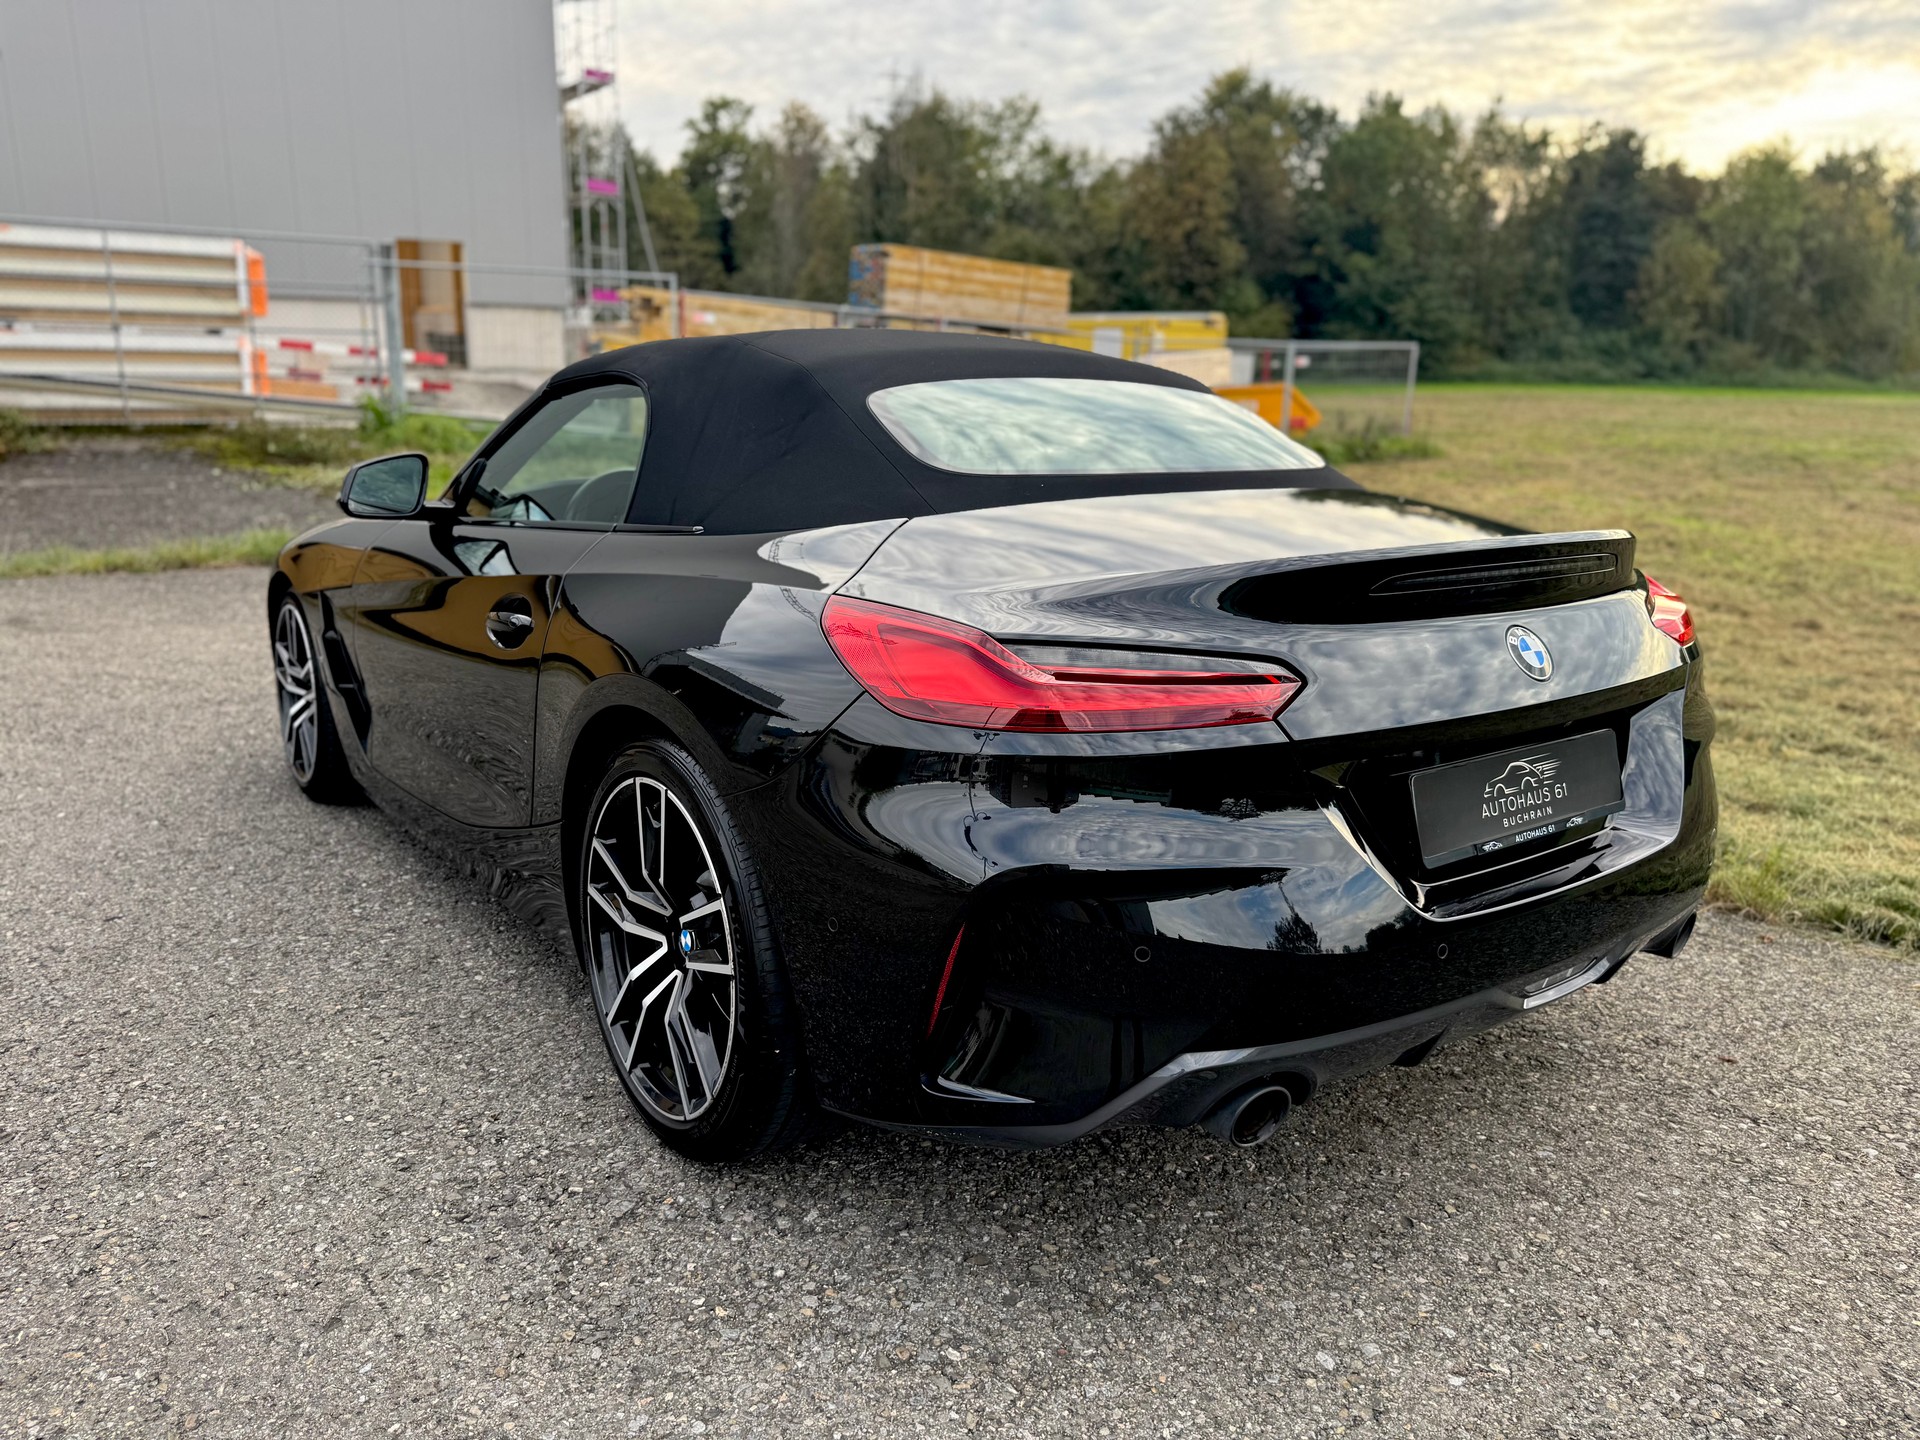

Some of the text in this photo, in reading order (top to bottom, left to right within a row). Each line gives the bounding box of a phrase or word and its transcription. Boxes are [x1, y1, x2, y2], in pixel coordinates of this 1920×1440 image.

[1482, 782, 1568, 818] AUTOHAUS 61
[1503, 806, 1552, 827] BUCHRAIN
[1515, 824, 1555, 842] AUTOHAUS 61
